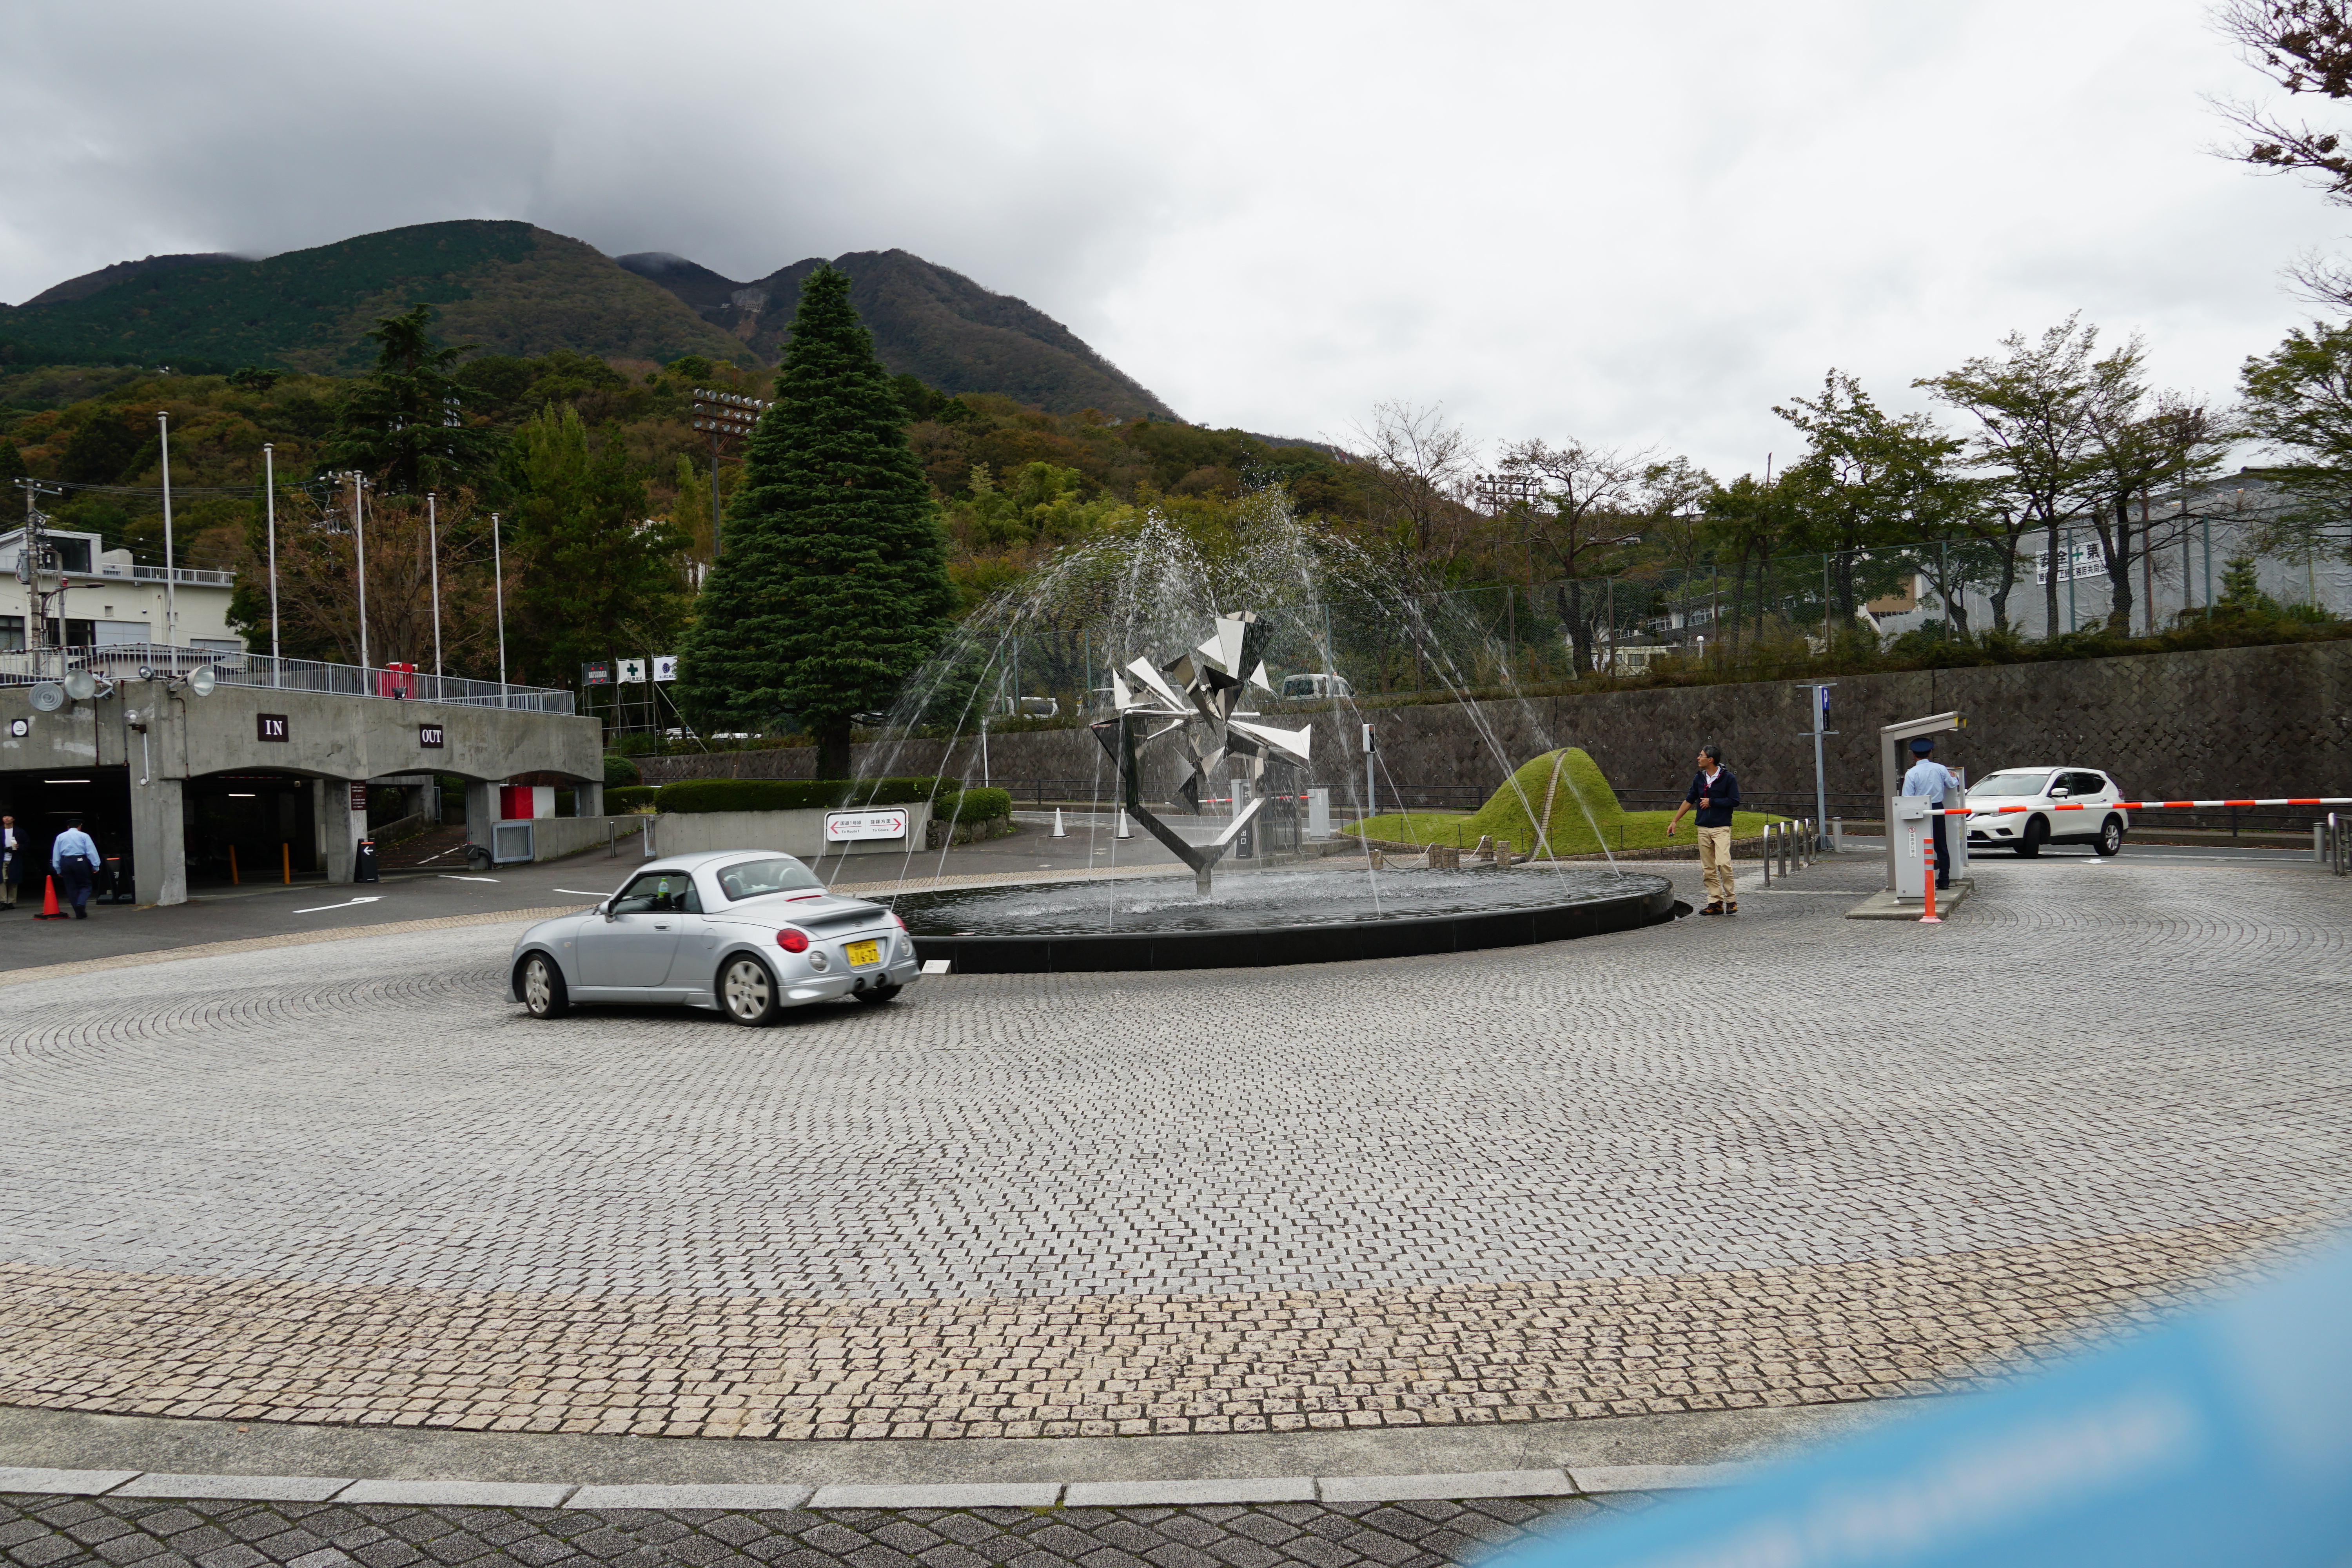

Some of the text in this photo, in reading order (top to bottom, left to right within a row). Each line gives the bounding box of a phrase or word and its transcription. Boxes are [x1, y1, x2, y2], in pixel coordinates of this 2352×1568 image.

[1824, 689, 1828, 708] P
[265, 720, 283, 735] IN
[422, 729, 441, 743] OUT
